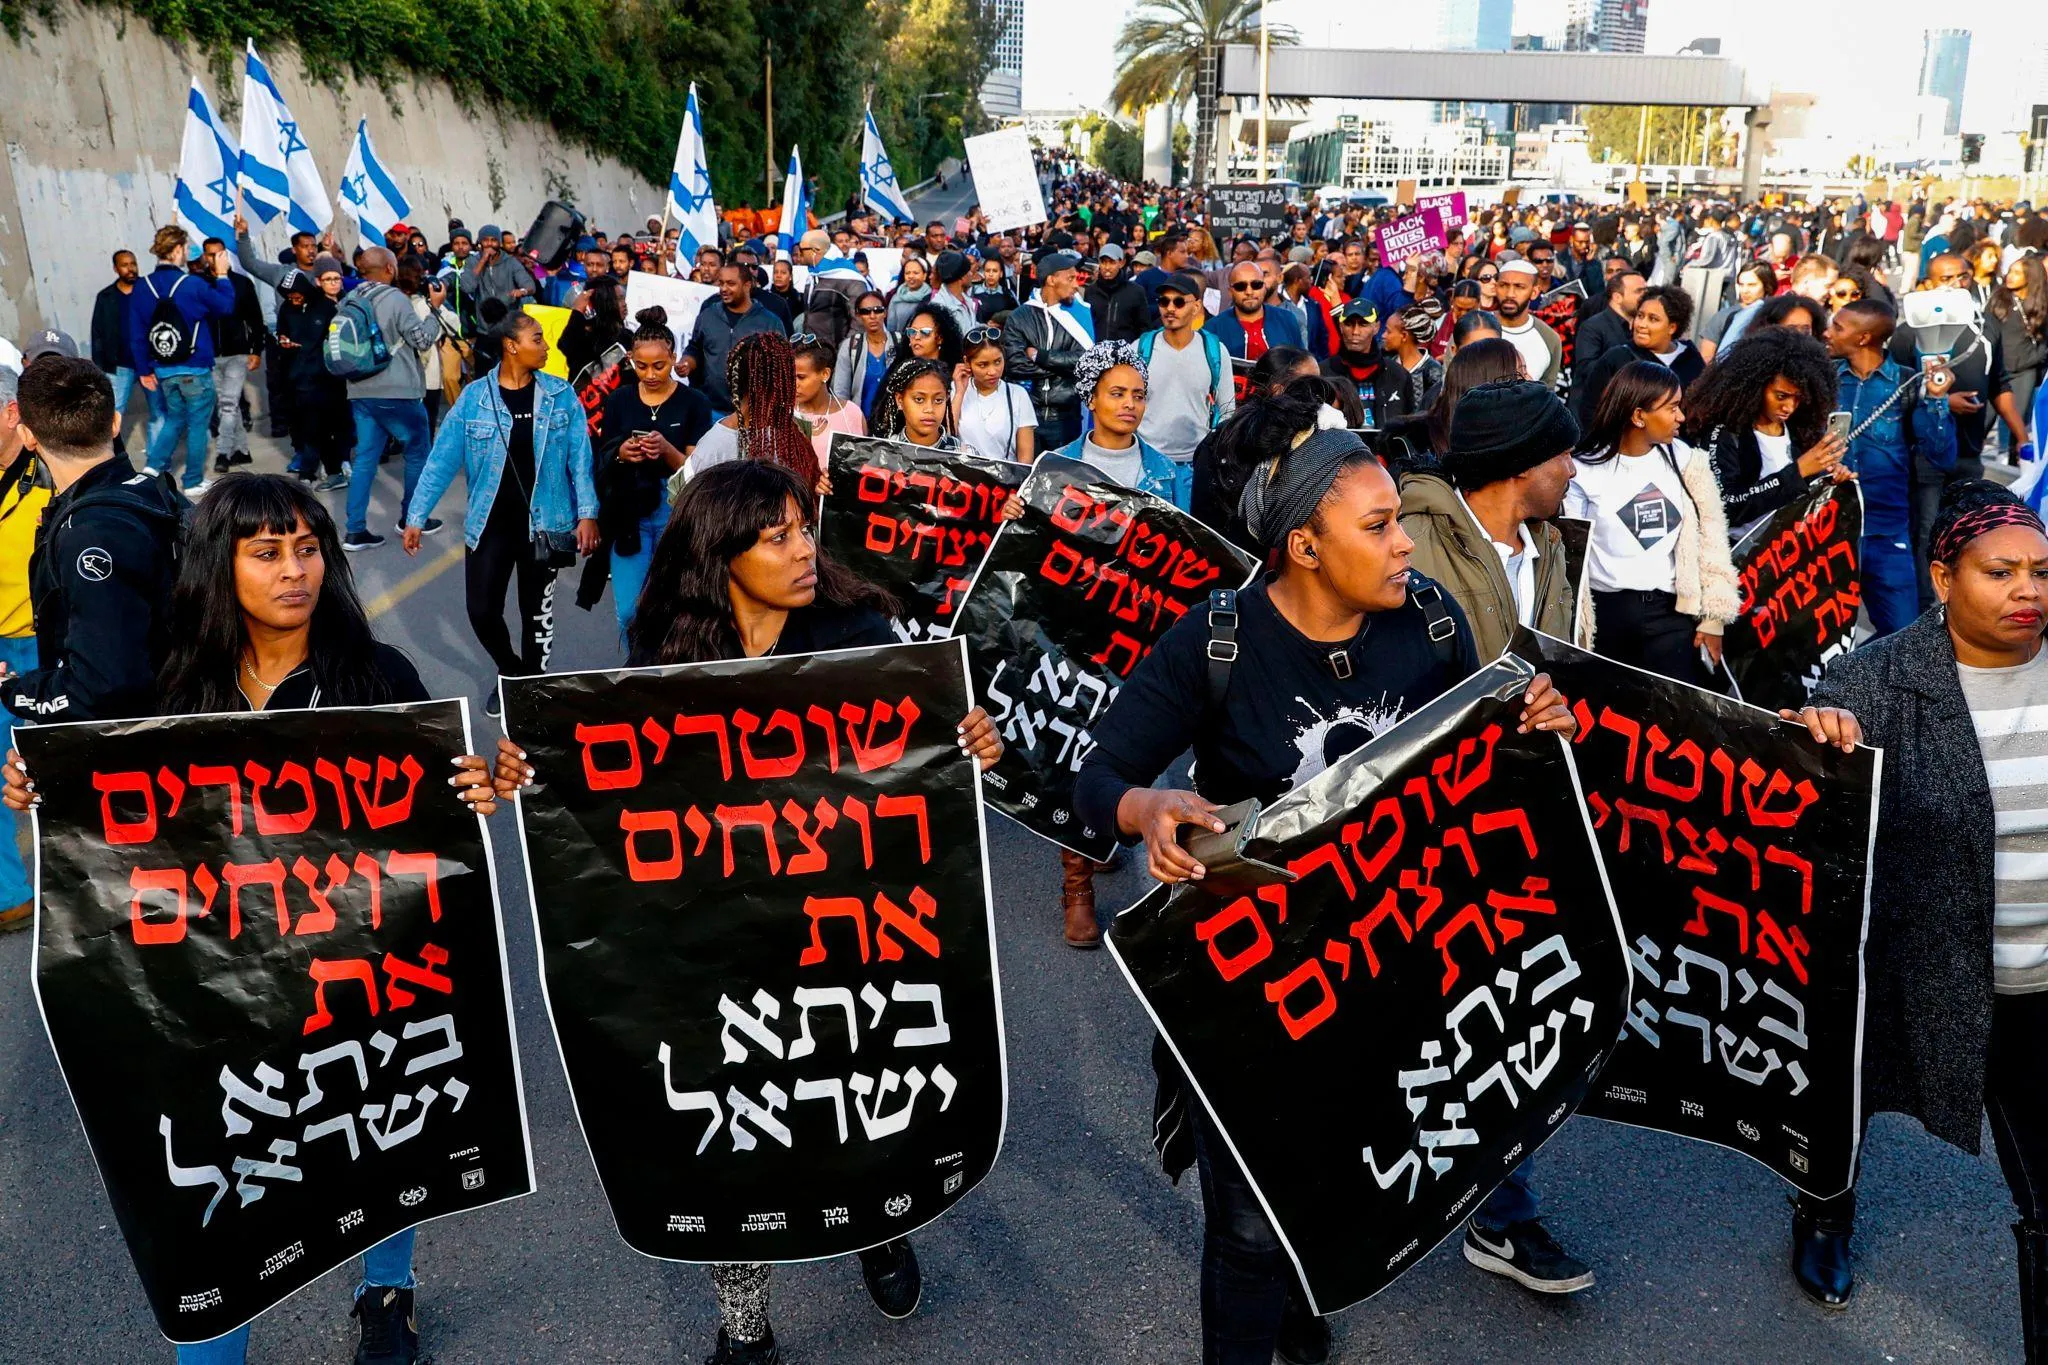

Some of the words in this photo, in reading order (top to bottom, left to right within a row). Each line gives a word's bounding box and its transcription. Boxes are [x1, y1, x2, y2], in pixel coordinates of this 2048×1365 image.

[1420, 196, 1452, 209] BLACK
[1381, 214, 1425, 239] BLACK
[1385, 227, 1425, 251] LIVES
[1387, 236, 1440, 263] MATTER
[1051, 484, 1220, 589] שוטרים
[1752, 540, 1857, 648] רוצחים
[1814, 580, 1860, 644] את
[575, 695, 921, 791] שוטרים
[1562, 695, 1820, 828] שוטרי
[92, 754, 424, 845] שוטרים
[619, 794, 931, 882] רוצחים
[1196, 723, 1502, 982] שוטרים
[1588, 791, 1814, 915] רוצחי
[130, 849, 442, 945] רוצחים
[800, 886, 940, 967] את
[1264, 808, 1538, 1041] רוצחים
[1434, 876, 1557, 996] את
[1683, 886, 1811, 985] את
[303, 942, 453, 1036] את
[717, 980, 951, 1065] ביתא
[1398, 934, 1581, 1122] ביתא
[1618, 998, 1810, 1096] ישרא
[218, 1013, 464, 1137] ביתא
[657, 1041, 958, 1157] ישראל
[1362, 996, 1594, 1204] ישראל
[1605, 1090, 1647, 1104] השופטת
[1612, 1085, 1647, 1098] הרשות
[1680, 1100, 1704, 1111] גלעד
[1681, 1106, 1704, 1118] ארדן
[1781, 1124, 1809, 1144] בחסות
[159, 1078, 470, 1228] ישראל
[449, 1145, 480, 1160] בחסות
[934, 1151, 964, 1166] בחסות
[337, 1208, 363, 1225] גלעד
[339, 1215, 365, 1234] ארדן
[667, 1222, 706, 1233] הראשית
[670, 1215, 704, 1225] הרבנות
[741, 1220, 787, 1232] השופטת
[748, 1212, 786, 1223] הרשות
[822, 1206, 848, 1218] גלעד
[824, 1215, 850, 1228] ארדן
[259, 1248, 305, 1280] השופטת
[265, 1240, 303, 1268] הרשות
[178, 1296, 223, 1313] הראשית
[181, 1287, 220, 1304] הרבנות
